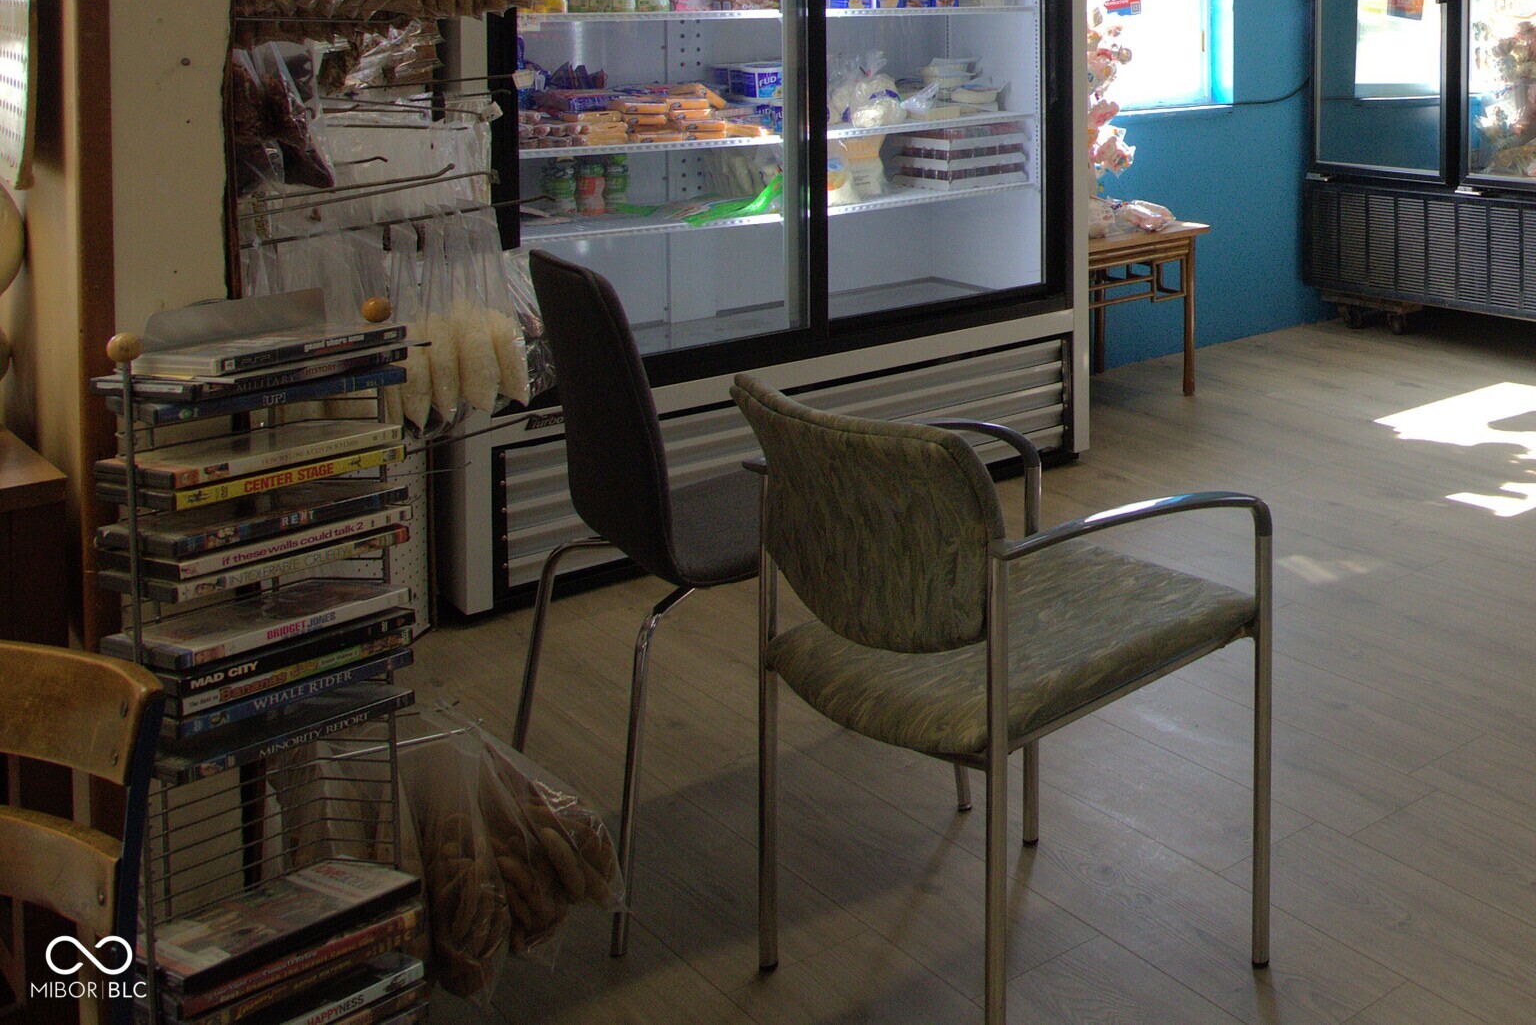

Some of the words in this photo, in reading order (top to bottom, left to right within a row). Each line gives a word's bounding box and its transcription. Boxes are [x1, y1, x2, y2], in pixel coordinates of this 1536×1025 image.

[759, 76, 777, 87] FUD
[236, 372, 296, 393] MILITARY
[303, 364, 337, 376] HISTORY
[244, 470, 293, 493] CENTER
[297, 462, 334, 481] STAGE
[281, 510, 314, 527] RENT
[222, 556, 231, 566] if
[232, 549, 267, 563] these
[265, 538, 299, 556] walls
[299, 529, 333, 546] could
[334, 524, 355, 539] talk
[356, 522, 364, 531] 2
[228, 557, 300, 586] INTOLERABLE
[304, 545, 350, 567] CRUELTY
[266, 620, 306, 640] BRIDGET
[307, 611, 337, 628] JONES
[190, 672, 225, 689] MAD
[228, 661, 259, 678] CITY
[219, 671, 289, 703] Bananas
[253, 686, 305, 711] WHALE
[308, 671, 352, 693] RIDER
[258, 728, 323, 758] MINORITY
[325, 712, 370, 735] REPORT
[307, 995, 365, 1025] HAPPYNESS
